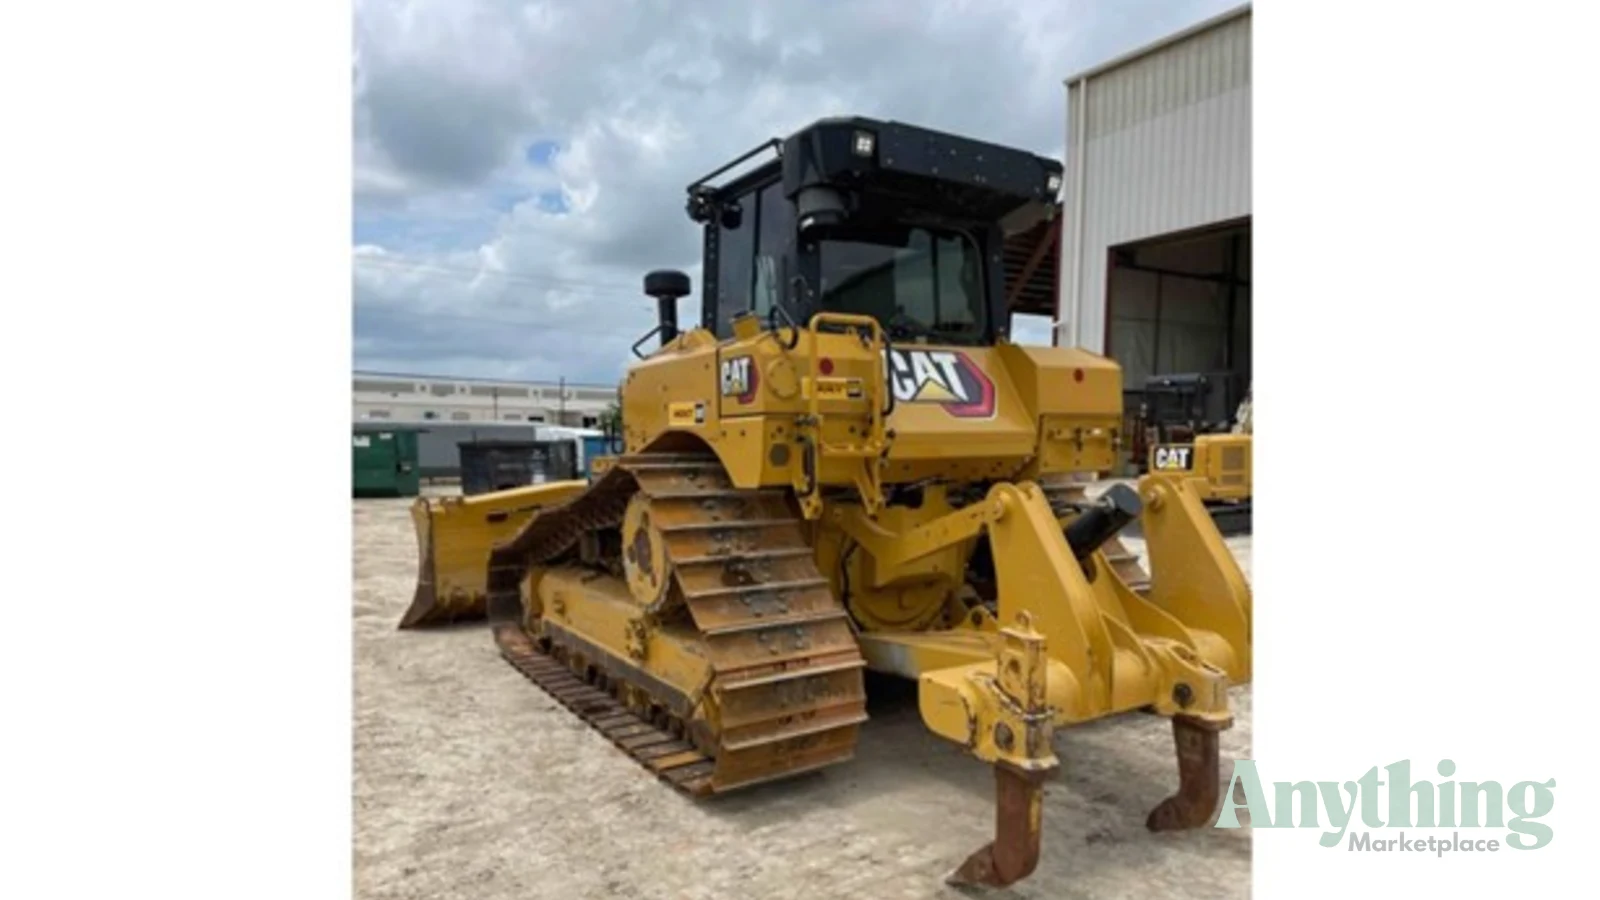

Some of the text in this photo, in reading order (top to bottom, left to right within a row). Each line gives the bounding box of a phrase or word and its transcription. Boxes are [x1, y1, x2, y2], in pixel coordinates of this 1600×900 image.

[721, 358, 749, 395] CAT
[880, 350, 969, 402] CAT
[1155, 447, 1190, 469] CAT
